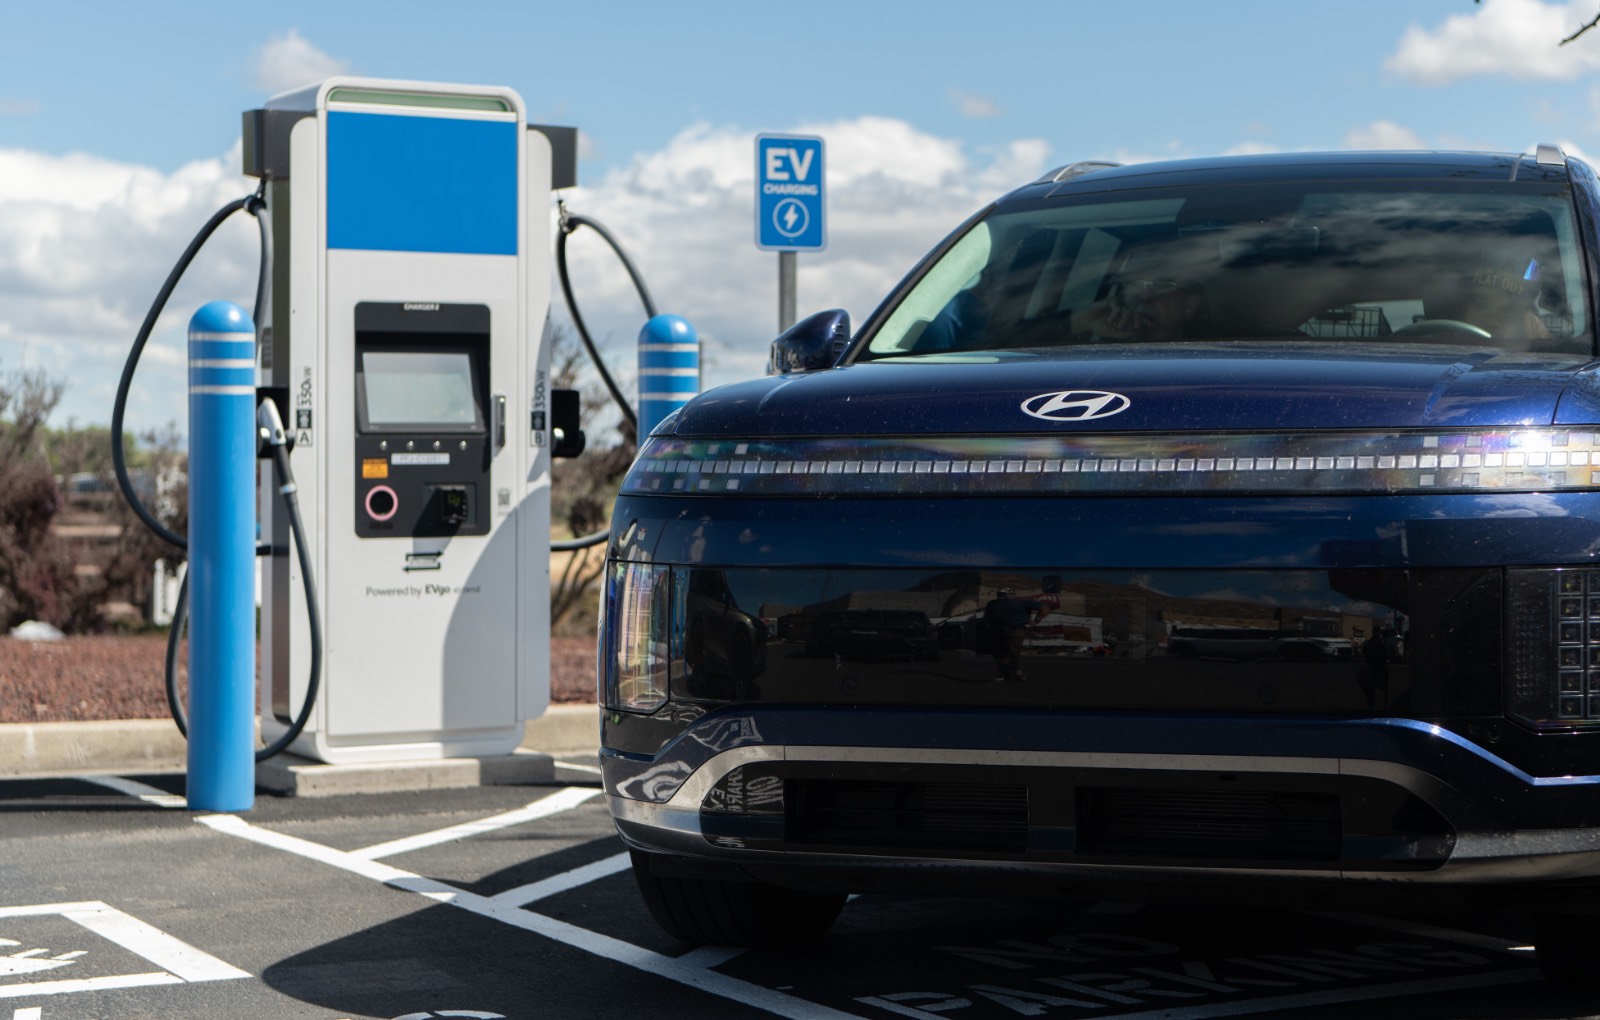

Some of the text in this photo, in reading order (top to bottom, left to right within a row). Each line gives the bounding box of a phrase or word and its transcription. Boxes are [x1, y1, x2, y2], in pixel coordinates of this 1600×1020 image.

[766, 147, 815, 181] EV
[763, 183, 818, 196] CHARGING
[300, 431, 309, 443] A
[535, 432, 542, 444] B
[366, 585, 409, 597] Powered
[410, 585, 422, 597] by
[425, 584, 451, 596] EVgo
